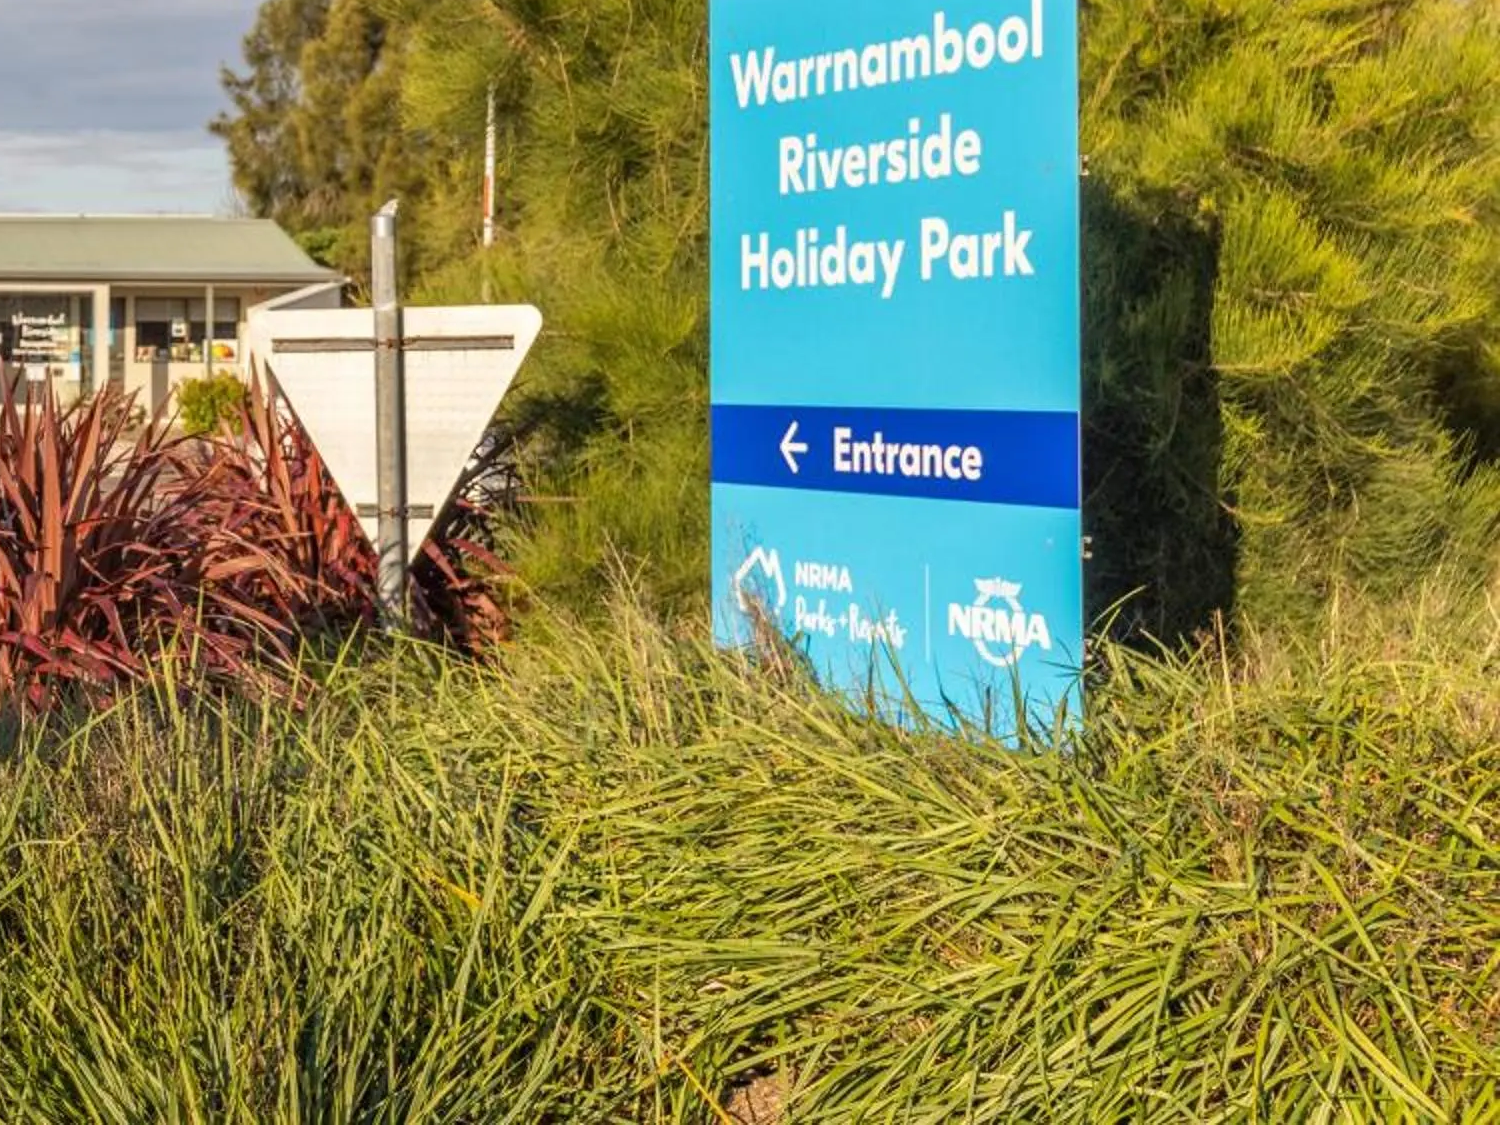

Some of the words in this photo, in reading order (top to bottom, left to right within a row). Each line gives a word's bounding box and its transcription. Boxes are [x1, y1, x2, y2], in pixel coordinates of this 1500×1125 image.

[778, 113, 982, 194] Riverside
[740, 225, 905, 299] Holiday
[920, 210, 1035, 280] Park
[833, 426, 984, 480] Entrance
[795, 561, 853, 593] NRMA
[947, 602, 1053, 650] NRMA
